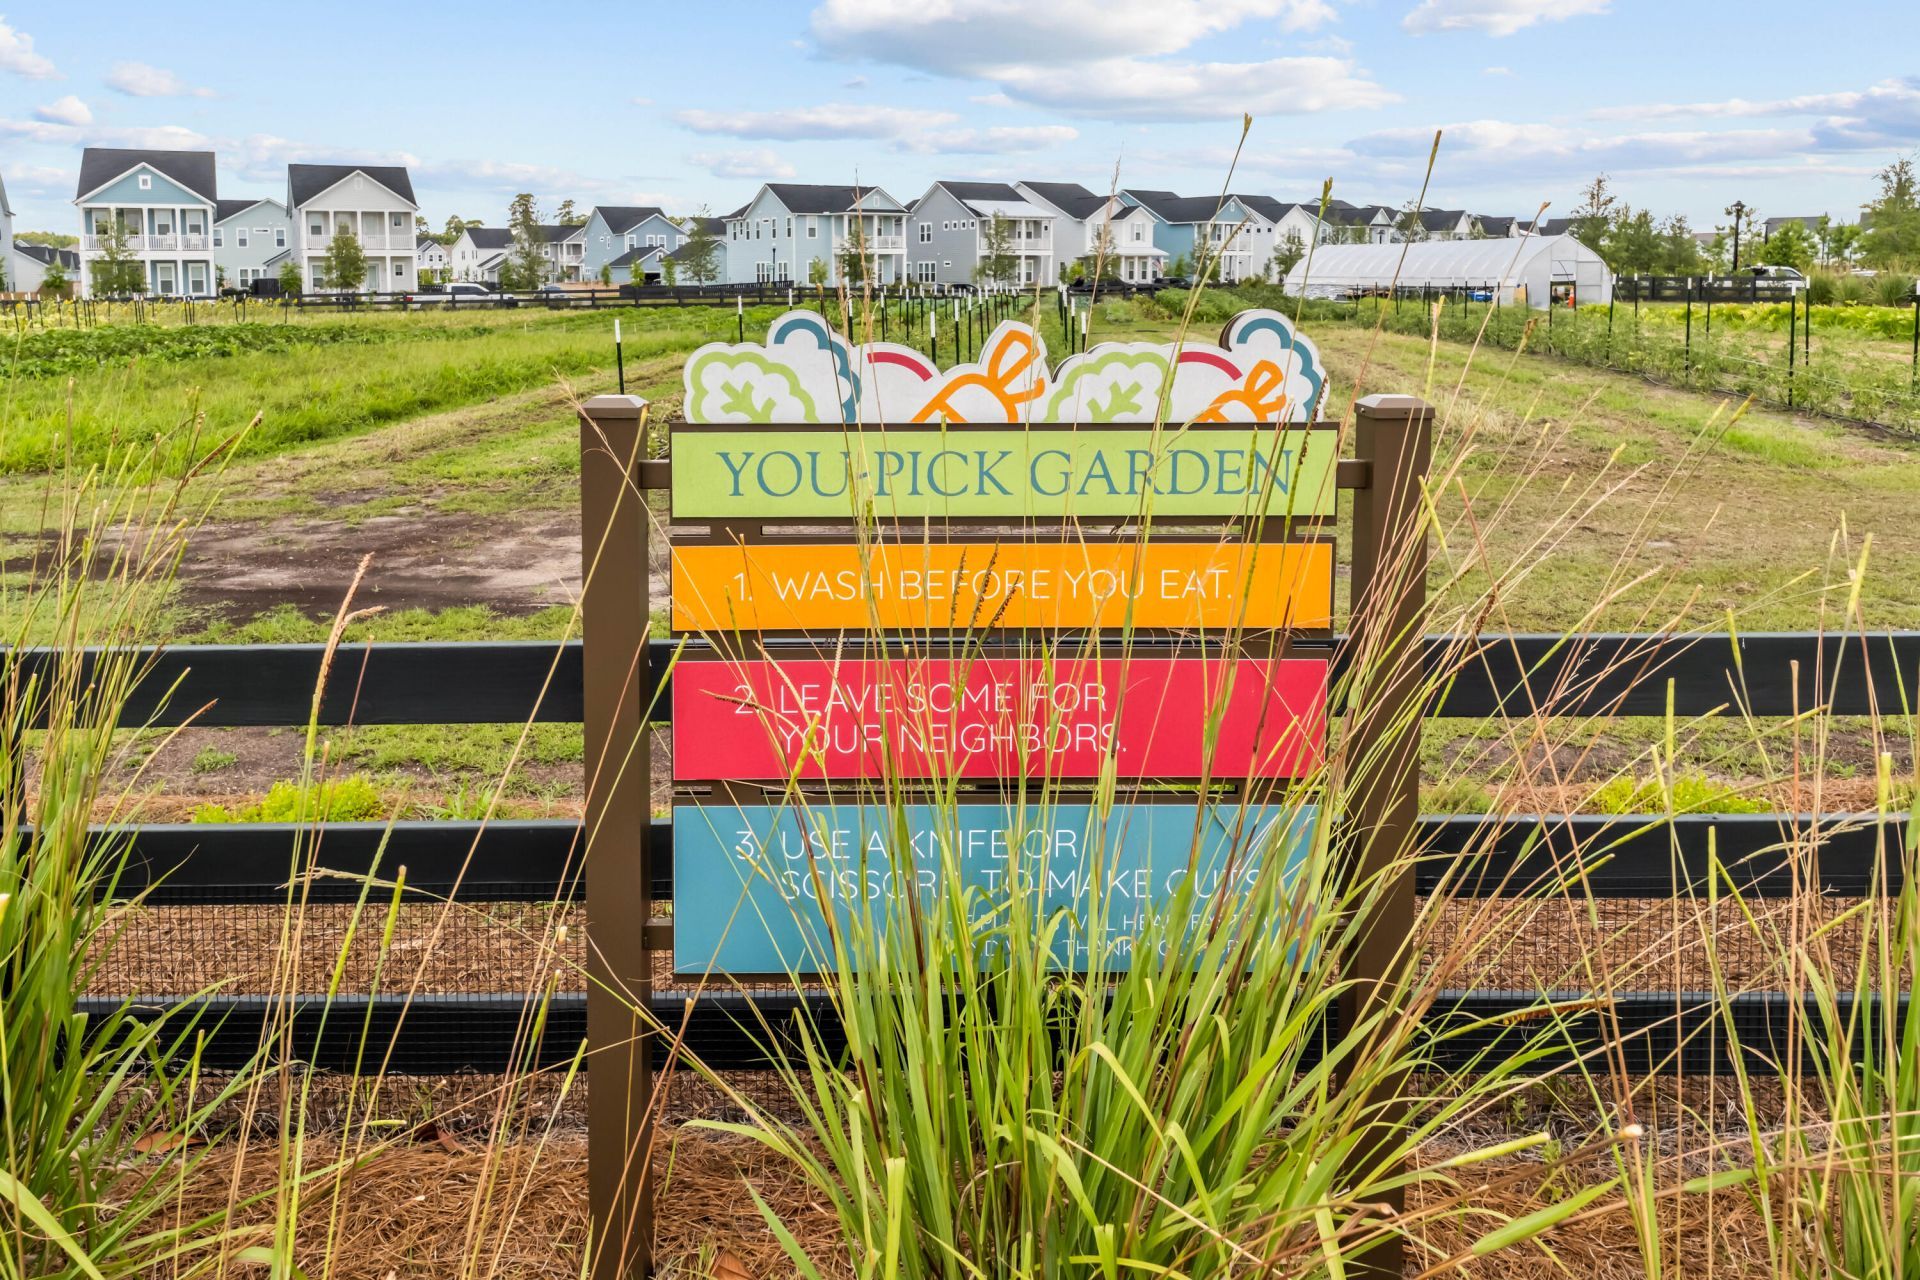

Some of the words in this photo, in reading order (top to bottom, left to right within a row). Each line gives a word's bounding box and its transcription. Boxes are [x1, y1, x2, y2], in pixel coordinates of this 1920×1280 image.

[716, 450, 1013, 498] YOU-PICK
[1030, 450, 1293, 496] GARDEN
[733, 571, 753, 601] 1.
[772, 570, 883, 601] WASH
[900, 569, 1050, 600] BEFORE
[1064, 569, 1144, 599] YOU
[1161, 569, 1232, 599] EAT.
[780, 683, 893, 714] LEAVE
[906, 683, 1013, 713] SOME
[1032, 683, 1107, 712] FOR
[778, 724, 884, 754] YOUR
[735, 830, 762, 860] 3.
[782, 830, 850, 859] USE
[866, 830, 888, 858] A
[905, 829, 1009, 858] KNIFE
[1021, 829, 1077, 858] OR
[1048, 869, 1153, 898] MAKE
